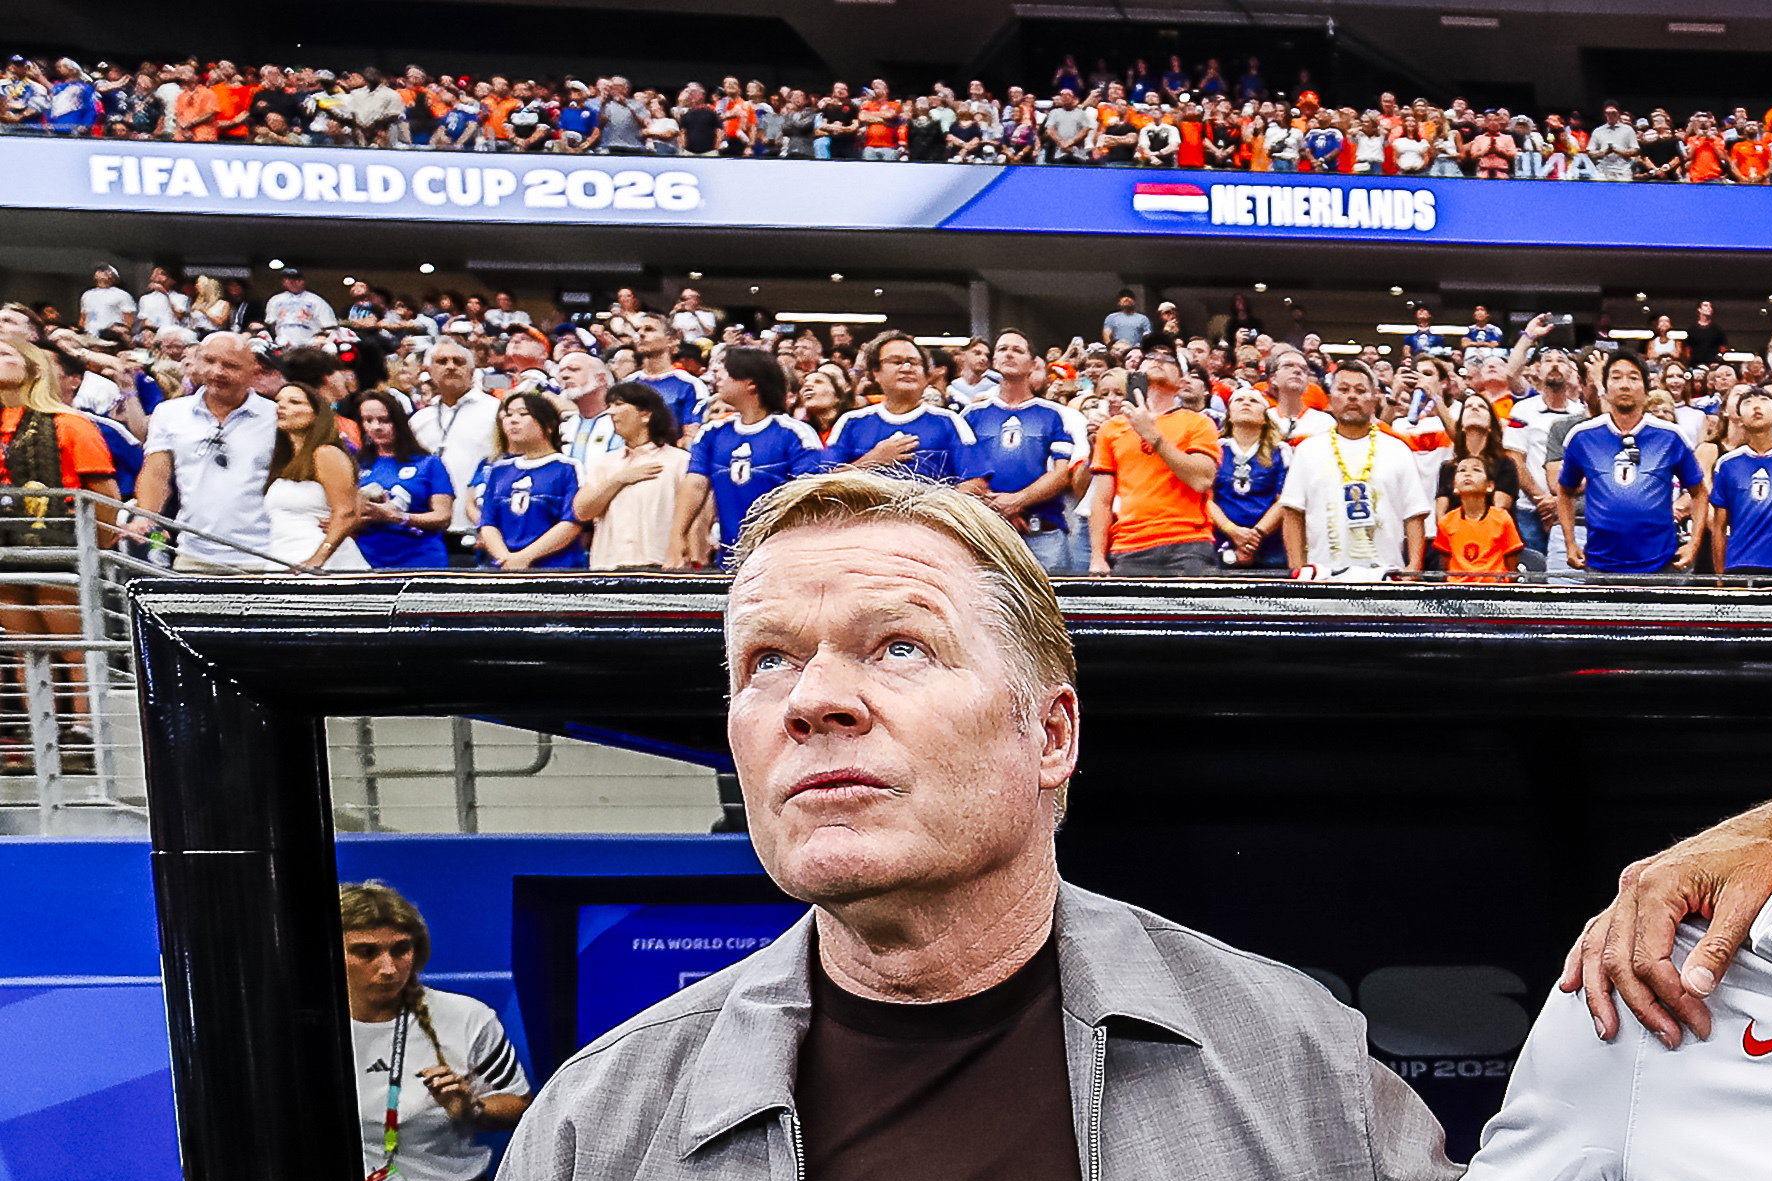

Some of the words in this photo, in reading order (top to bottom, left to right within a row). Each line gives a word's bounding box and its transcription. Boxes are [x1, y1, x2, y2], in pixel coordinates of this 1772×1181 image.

[89, 154, 208, 198] FIFA
[210, 158, 407, 204] WORLD
[411, 166, 518, 207] CUP
[522, 168, 702, 211] 2026
[1210, 184, 1437, 232] NETHERLANDS
[632, 937, 666, 950] FIFA
[667, 937, 724, 950] WORLD
[725, 937, 757, 950] CUP
[1433, 1060, 1514, 1078] 202
